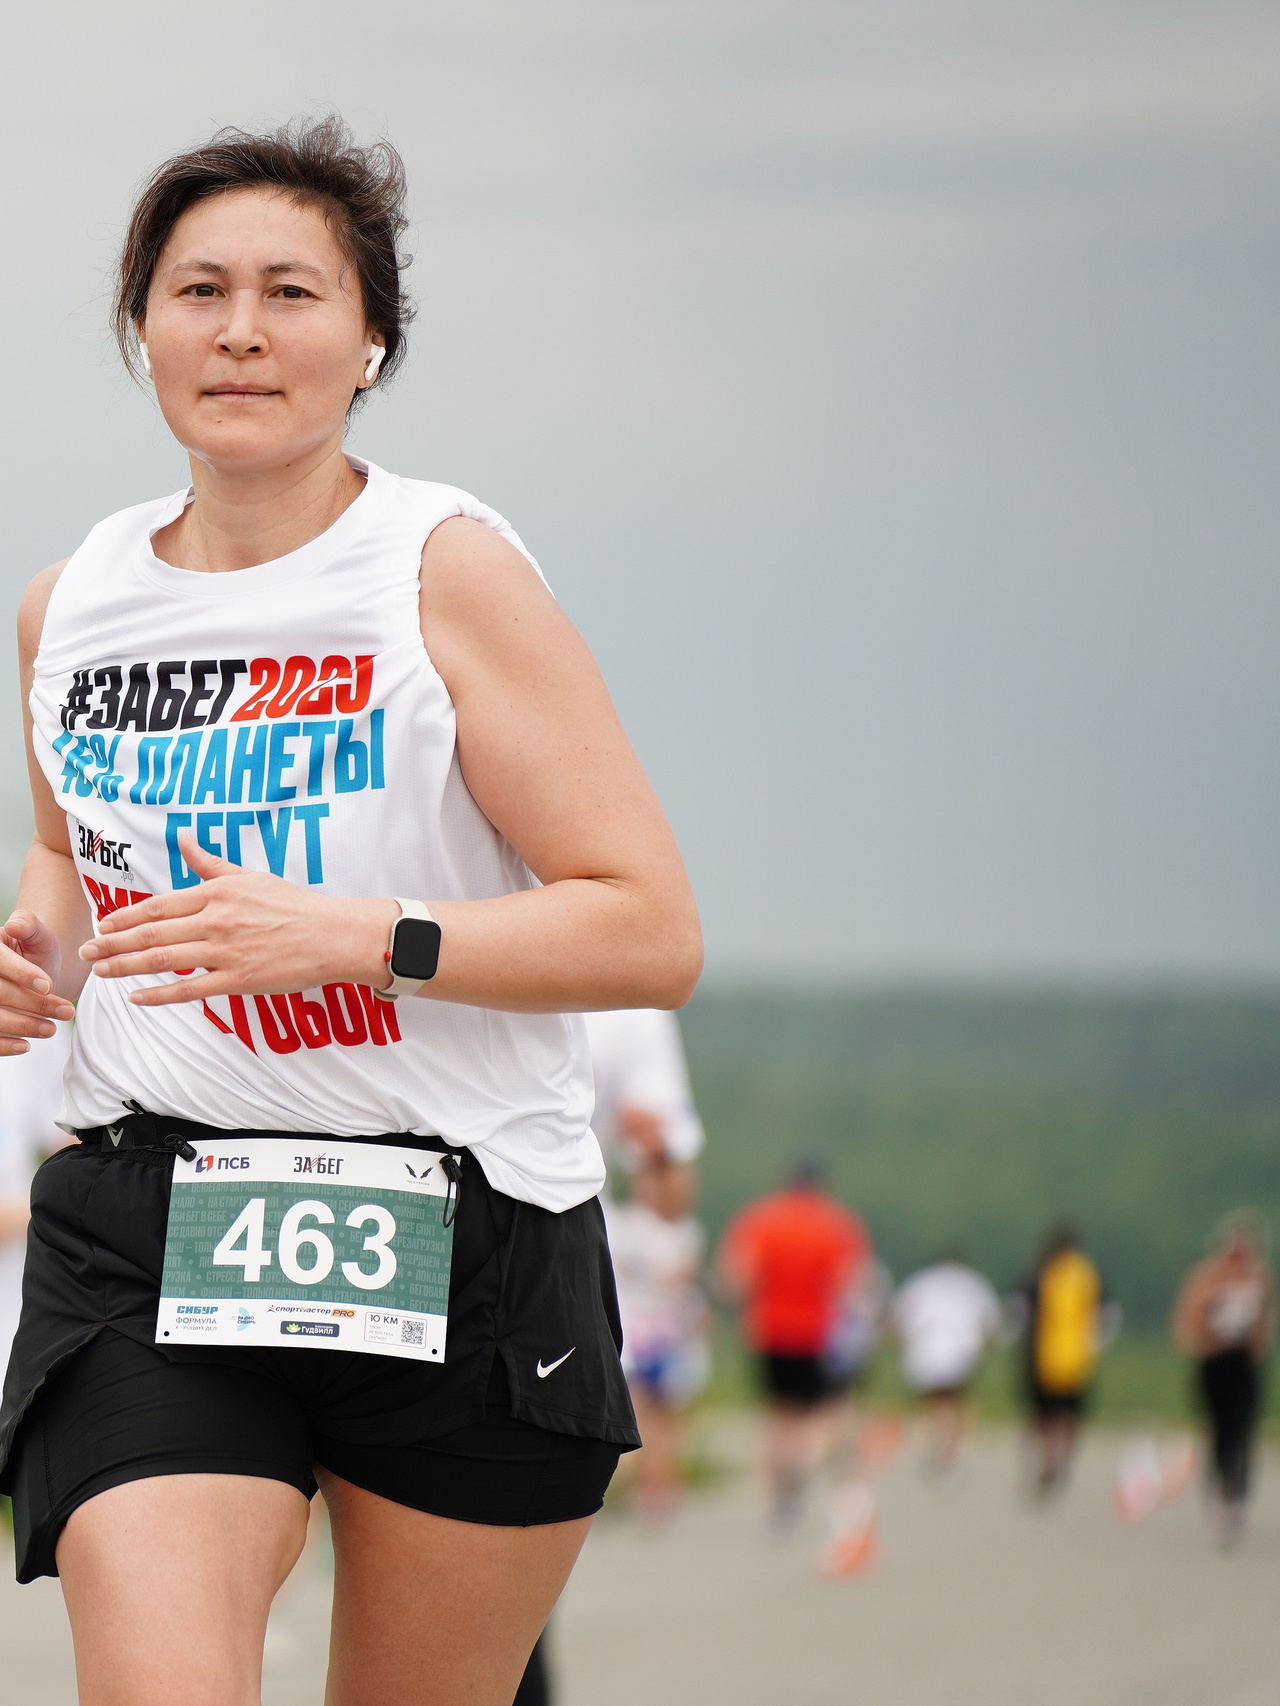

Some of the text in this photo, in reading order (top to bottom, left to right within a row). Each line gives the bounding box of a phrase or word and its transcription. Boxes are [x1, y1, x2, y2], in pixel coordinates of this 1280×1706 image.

[130, 708, 385, 805] ПЛАНЕТЫ
[217, 1157, 250, 1170] ПСБ
[293, 1155, 344, 1175] ЗАБЕГ
[213, 1198, 397, 1290] 463
[177, 1306, 218, 1314] СИБУР
[332, 1309, 355, 1318] PRO
[370, 1314, 381, 1322] 10
